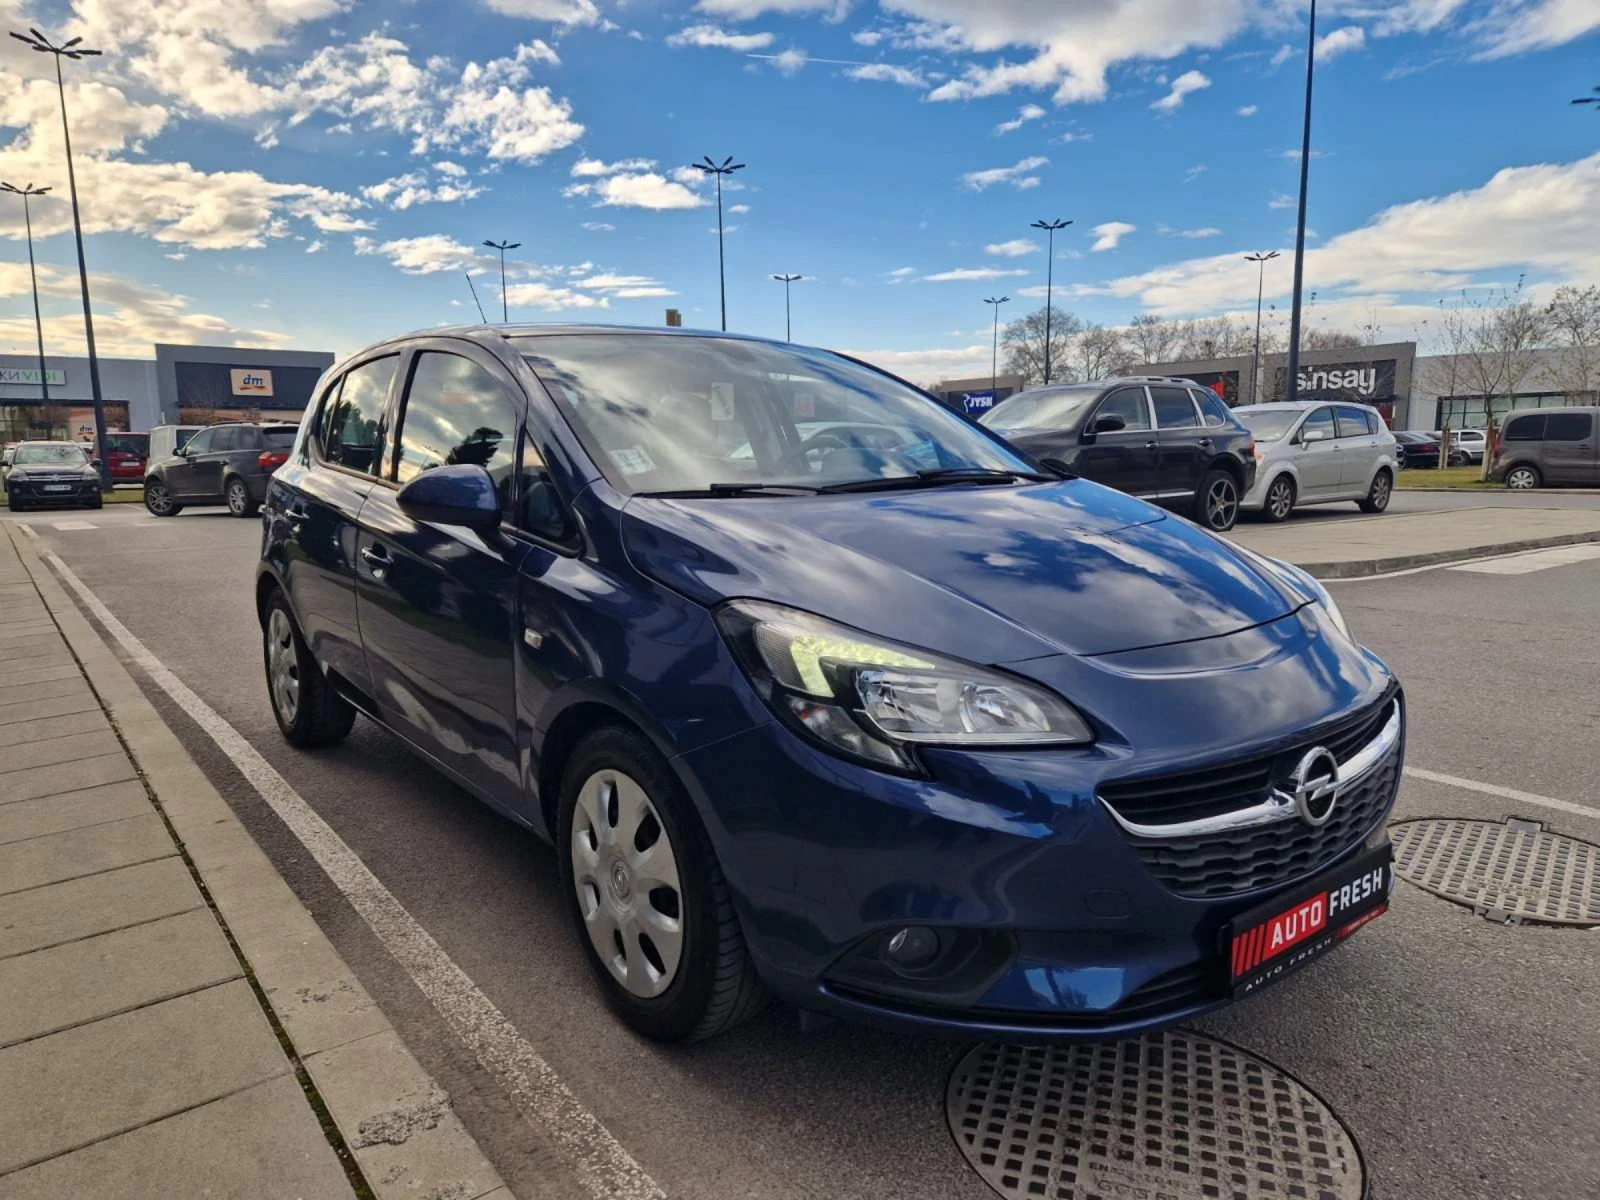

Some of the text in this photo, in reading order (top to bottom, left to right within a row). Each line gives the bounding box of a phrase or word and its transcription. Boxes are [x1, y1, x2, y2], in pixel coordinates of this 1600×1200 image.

[243, 374, 263, 385] dm
[1297, 367, 1376, 395] sinsay
[1271, 900, 1322, 949] AUTO
[1329, 867, 1383, 917] FRESH
[1245, 938, 1331, 992] AUTO FRESH
